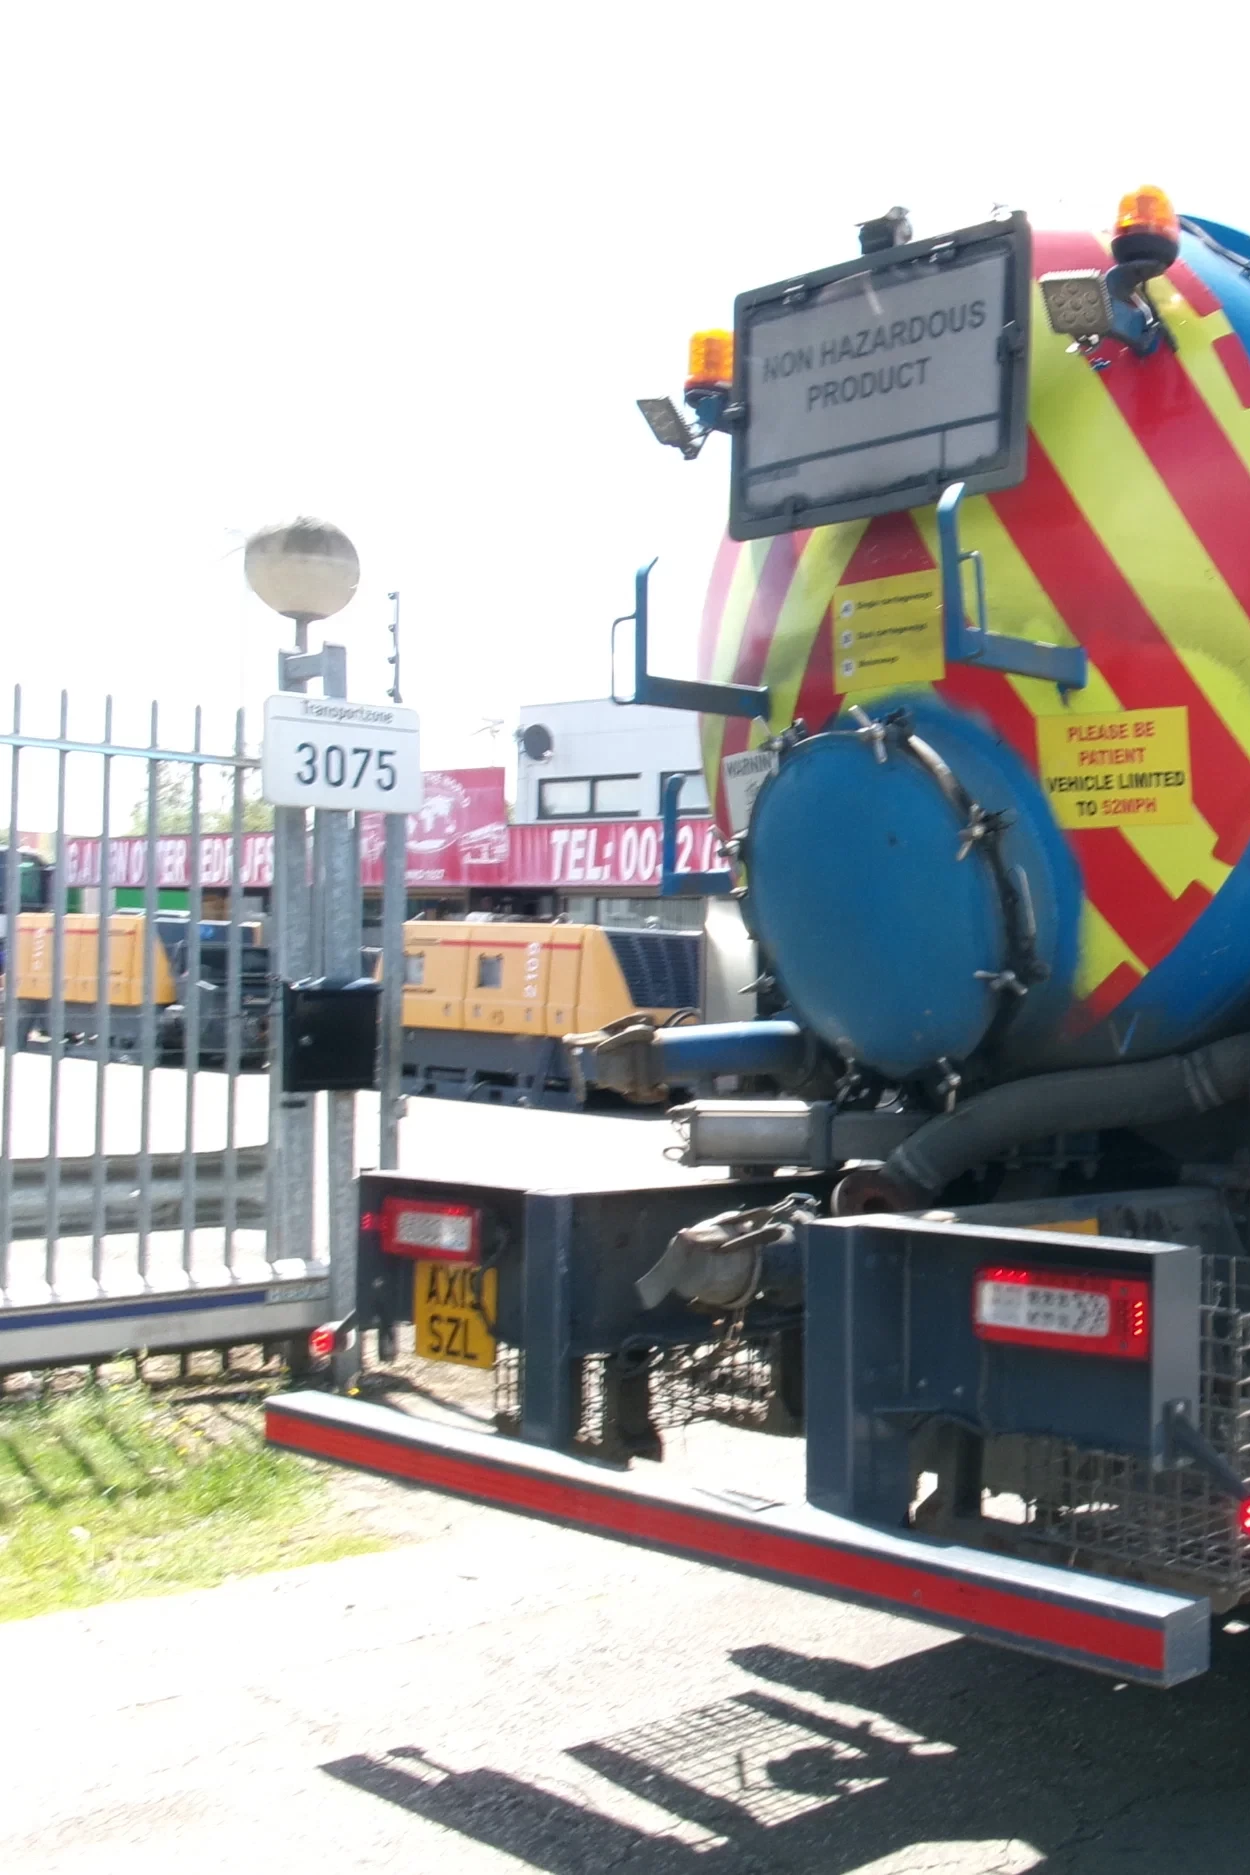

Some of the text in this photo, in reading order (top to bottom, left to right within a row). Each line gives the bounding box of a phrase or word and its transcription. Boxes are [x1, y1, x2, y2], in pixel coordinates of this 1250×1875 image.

[763, 300, 987, 384] NON HAZARDOUS
[806, 356, 932, 412] PRODUCT
[300, 700, 394, 724] Transportzone
[1067, 720, 1156, 743] PLEASE BE
[296, 741, 397, 791] 3075
[726, 752, 774, 779] WARNIN
[1078, 747, 1146, 767] PATIENT
[1046, 770, 1186, 794] VEHICLE LIMITED
[1076, 798, 1158, 816] TO 52MPH
[551, 828, 614, 882] TEL:
[428, 1314, 479, 1360] SZL
